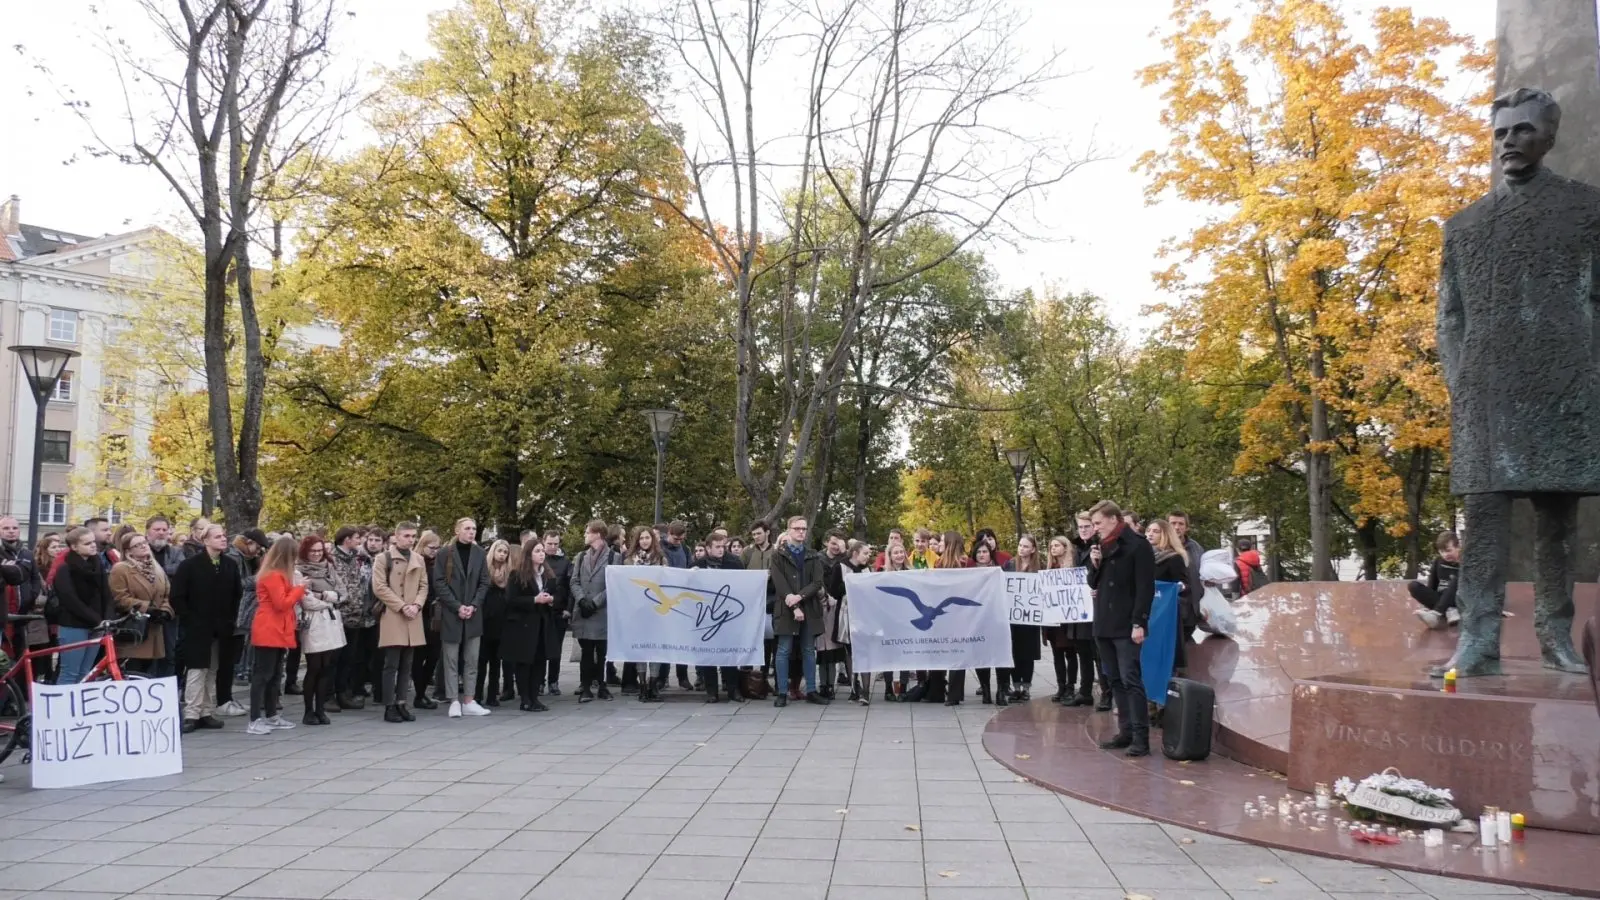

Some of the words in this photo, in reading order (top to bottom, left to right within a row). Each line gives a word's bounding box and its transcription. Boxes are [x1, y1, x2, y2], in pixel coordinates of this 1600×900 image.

[881, 638, 913, 646] LIETUVOS
[915, 637, 949, 645] LIBERALUS
[950, 635, 986, 645] JAUNIMAS
[40, 682, 165, 719] TIESOS
[36, 716, 176, 762] NEUŽTILDYSI
[1324, 723, 1410, 750] VINCAS
